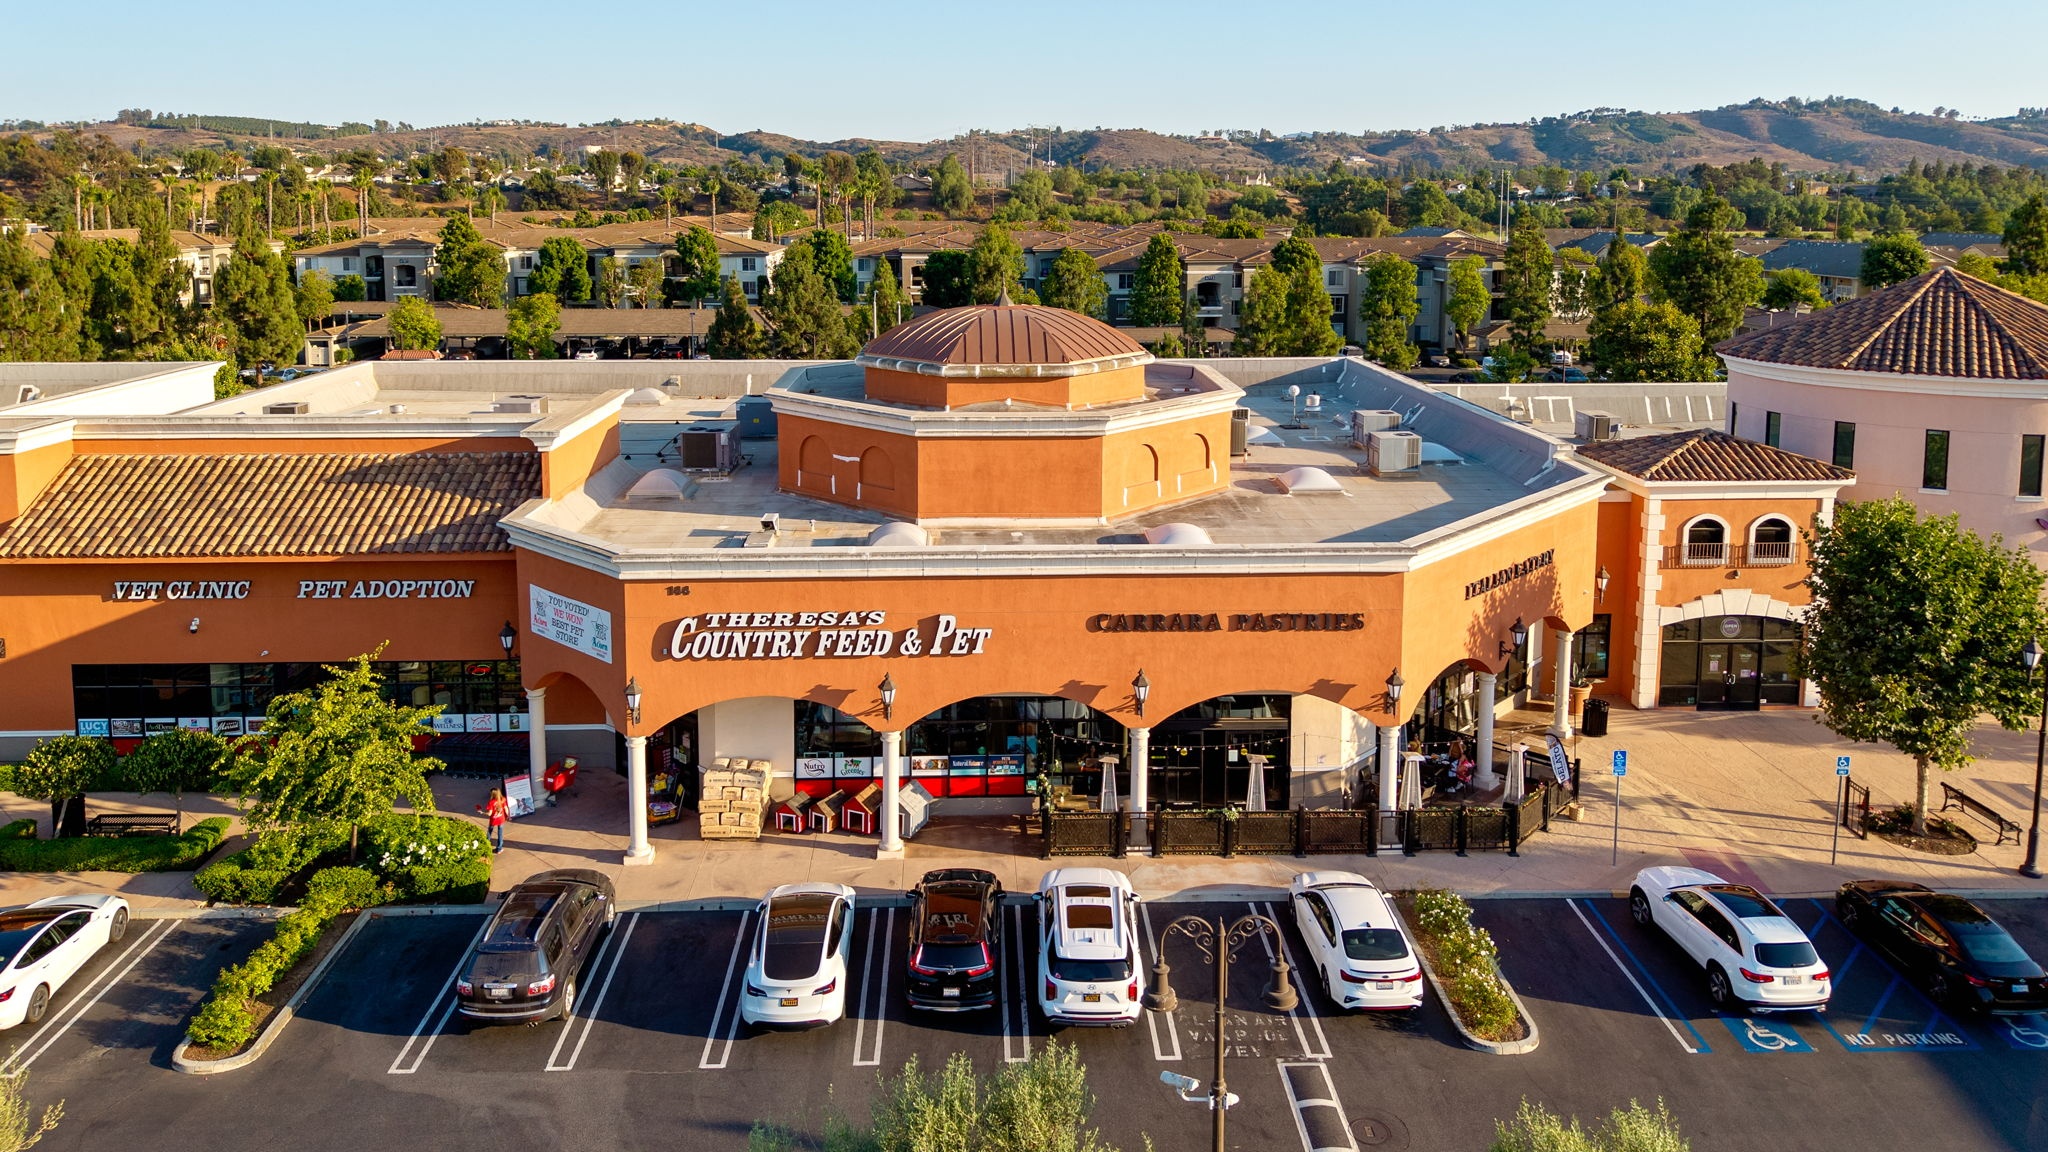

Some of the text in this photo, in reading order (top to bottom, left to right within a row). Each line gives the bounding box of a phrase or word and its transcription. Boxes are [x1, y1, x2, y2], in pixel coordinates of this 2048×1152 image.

[114, 580, 252, 600] VET CLINIC
[297, 580, 475, 599] PET ADOPTION
[548, 595, 590, 617] YOU VOTED!
[553, 607, 565, 619] WE
[552, 617, 570, 631] BEST
[570, 624, 585, 637] PET
[705, 610, 887, 629] THERESA'S
[1096, 612, 1365, 632] CARRARA PASTRIES
[555, 629, 579, 646] STORE
[670, 613, 993, 660] COUNTRY FEED & PET
[80, 721, 108, 731] LUCY
[804, 762, 825, 770] Nutro
[1553, 746, 1566, 780] GELATO
[1844, 1032, 1963, 1047] NO PARKING
